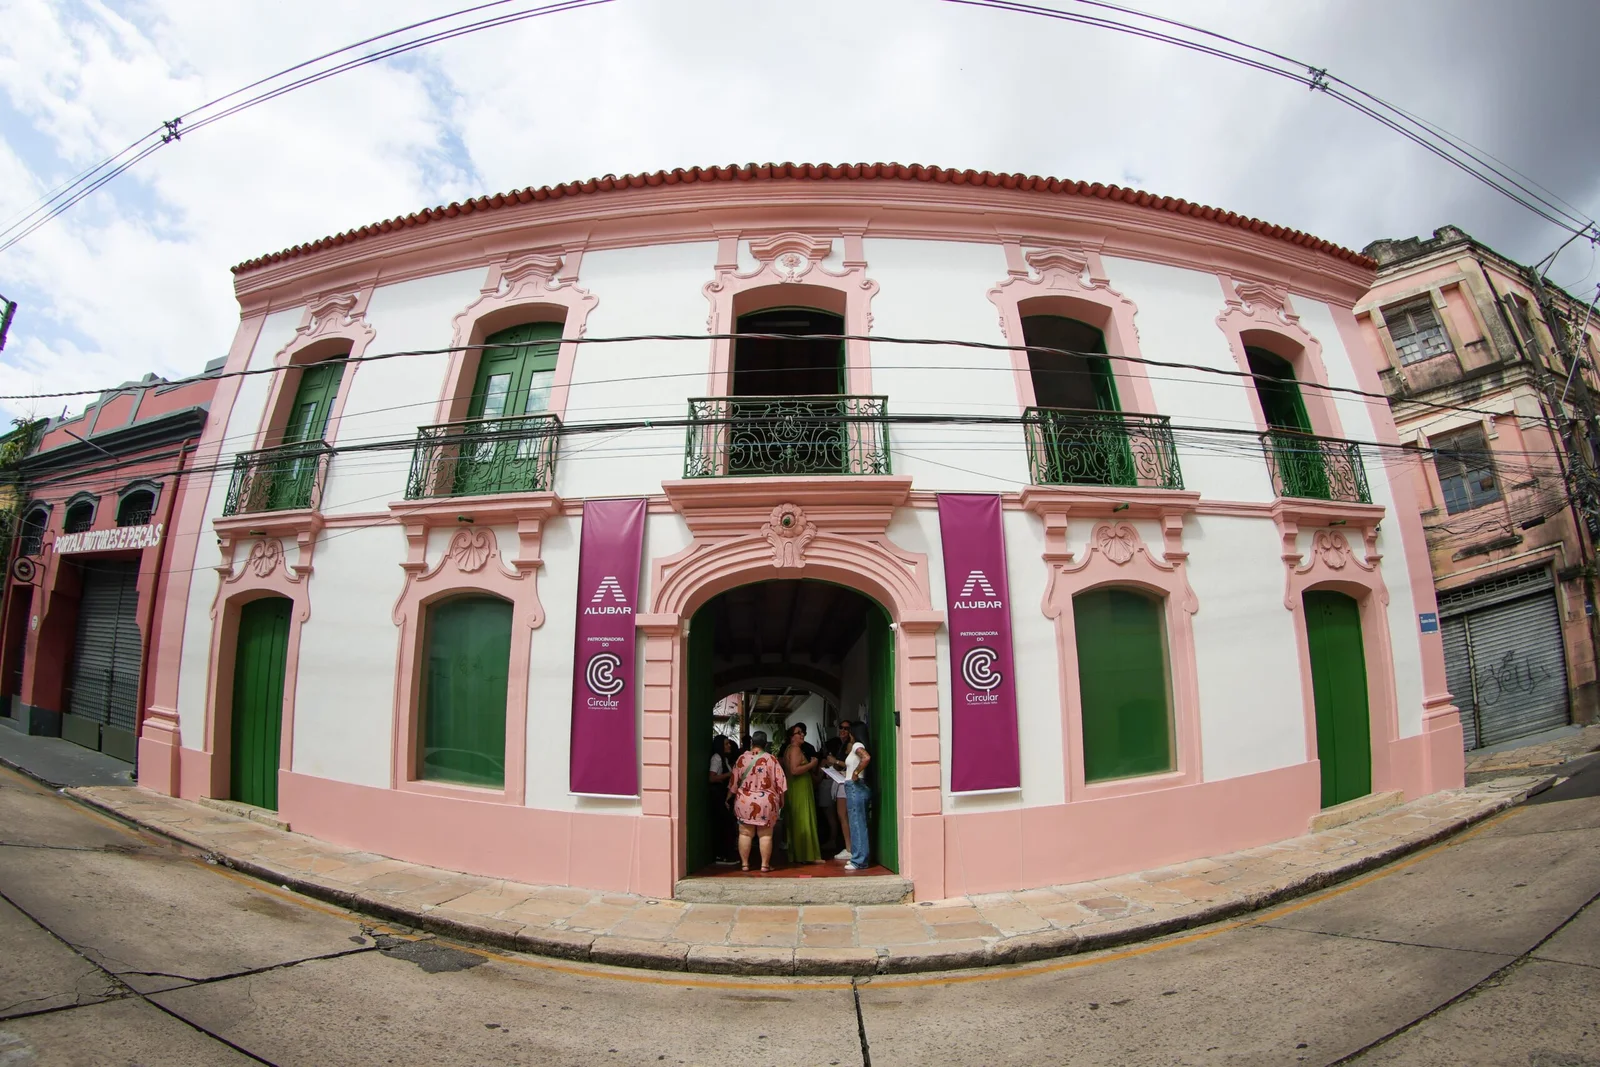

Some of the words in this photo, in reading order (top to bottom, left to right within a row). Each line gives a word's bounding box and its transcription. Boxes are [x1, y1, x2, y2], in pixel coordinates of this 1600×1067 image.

[53, 532, 83, 553] PORTAL
[81, 528, 120, 551] MOTORES
[118, 527, 128, 549] E
[125, 523, 164, 549] PEÇAS
[584, 607, 632, 615] ALUBAR
[953, 601, 1002, 609] ALUBAR
[587, 694, 619, 707] Circular
[966, 689, 999, 702] Circular
